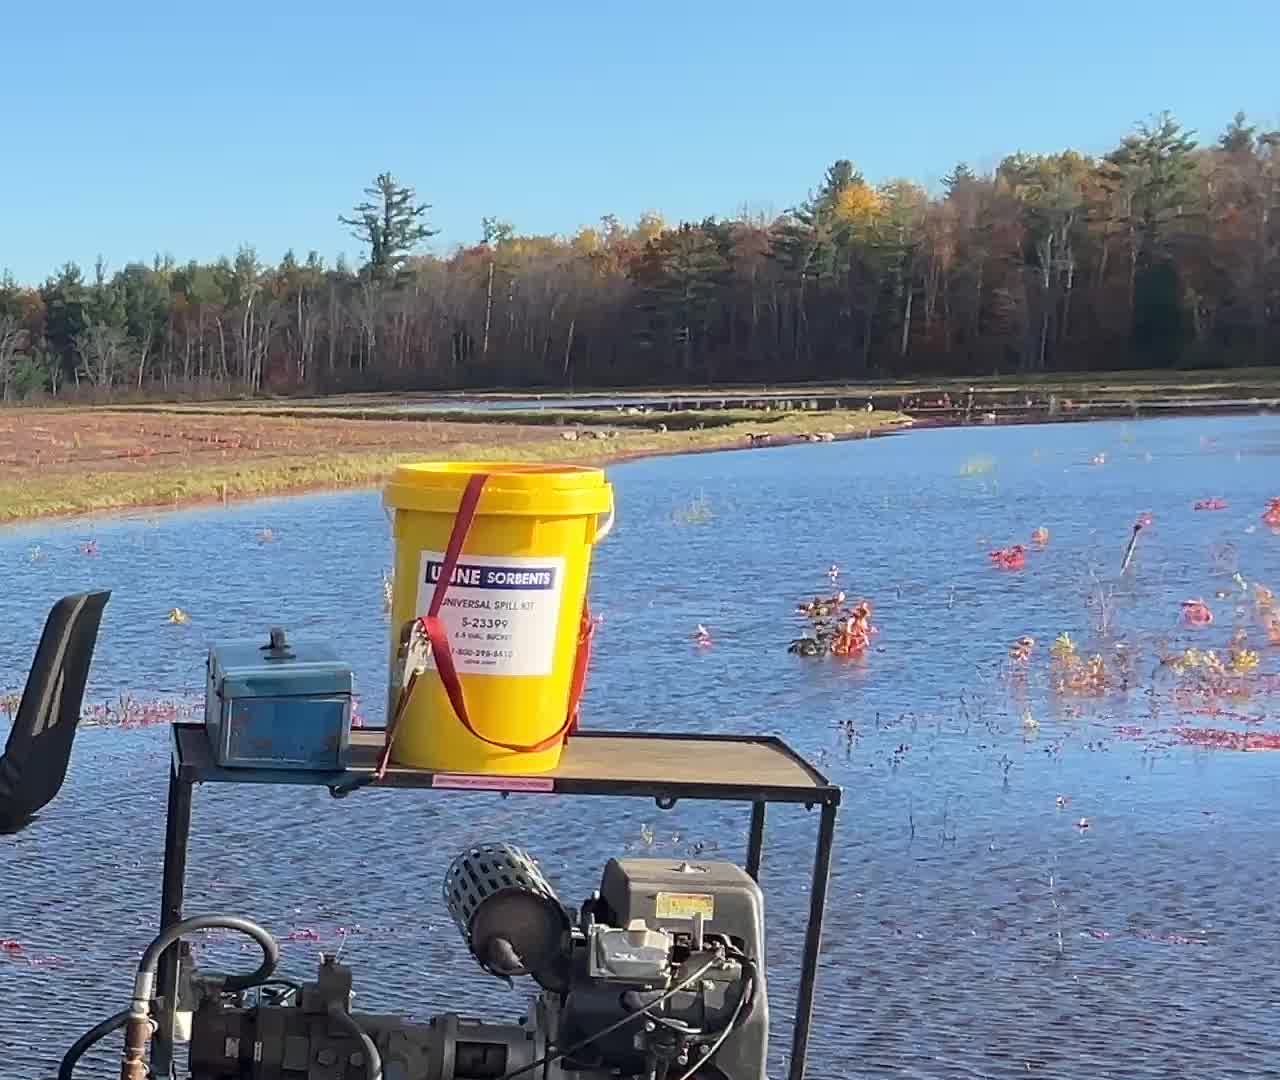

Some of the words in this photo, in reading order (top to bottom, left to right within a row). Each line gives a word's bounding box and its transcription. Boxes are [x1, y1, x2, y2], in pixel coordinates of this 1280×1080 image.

[430, 565, 481, 585] UINE
[487, 571, 551, 585] SORBENTS
[494, 601, 518, 610] SPILL
[462, 617, 509, 629] S-23399
